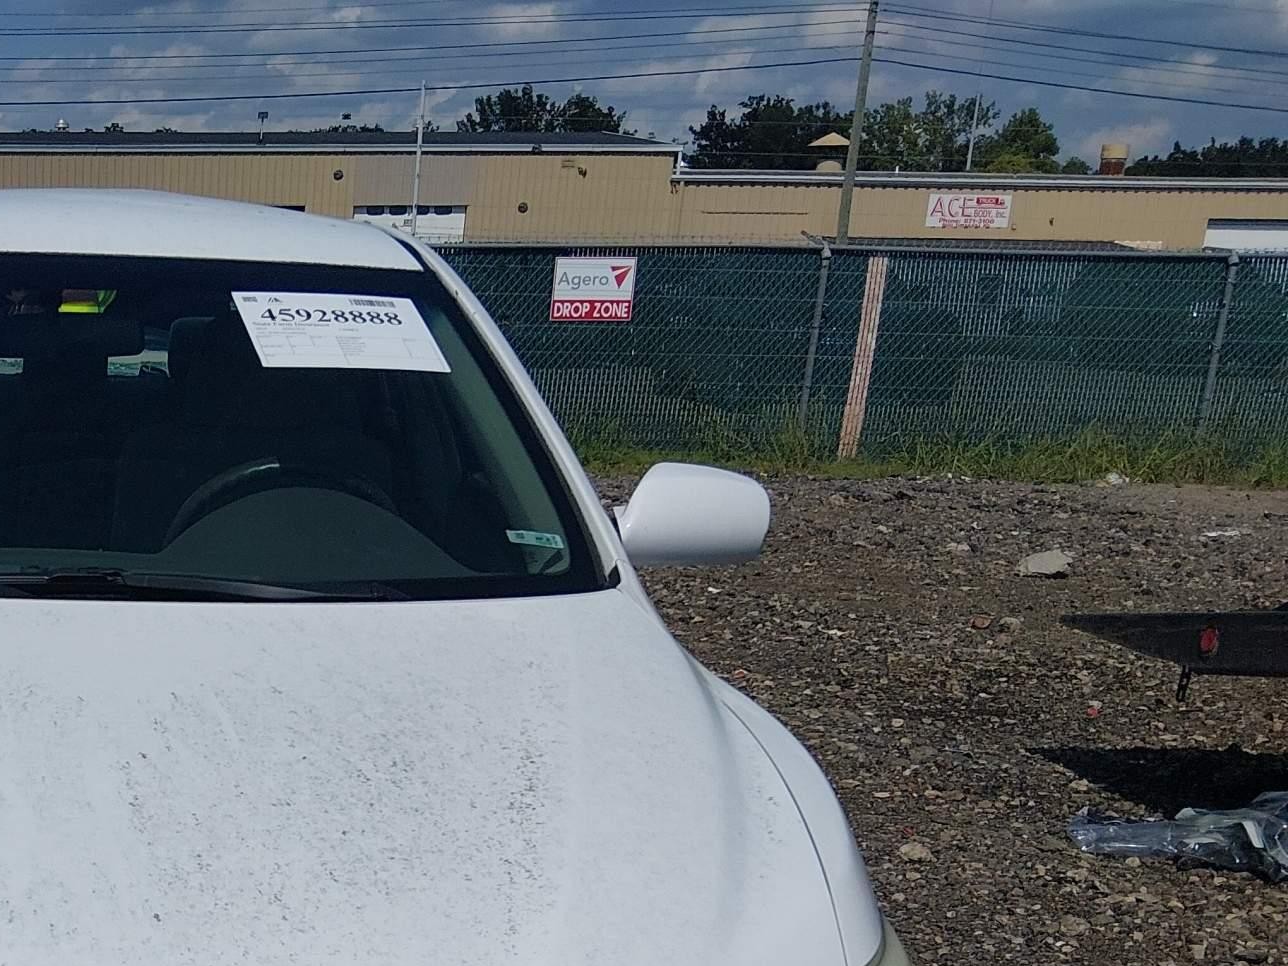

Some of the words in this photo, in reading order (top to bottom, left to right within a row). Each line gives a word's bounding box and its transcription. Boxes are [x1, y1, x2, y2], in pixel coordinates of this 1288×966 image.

[930, 196, 975, 218] ACE
[557, 271, 609, 290] Agero
[260, 307, 403, 326] 45928888
[553, 302, 591, 318] DROP
[592, 302, 630, 318] ZONE
